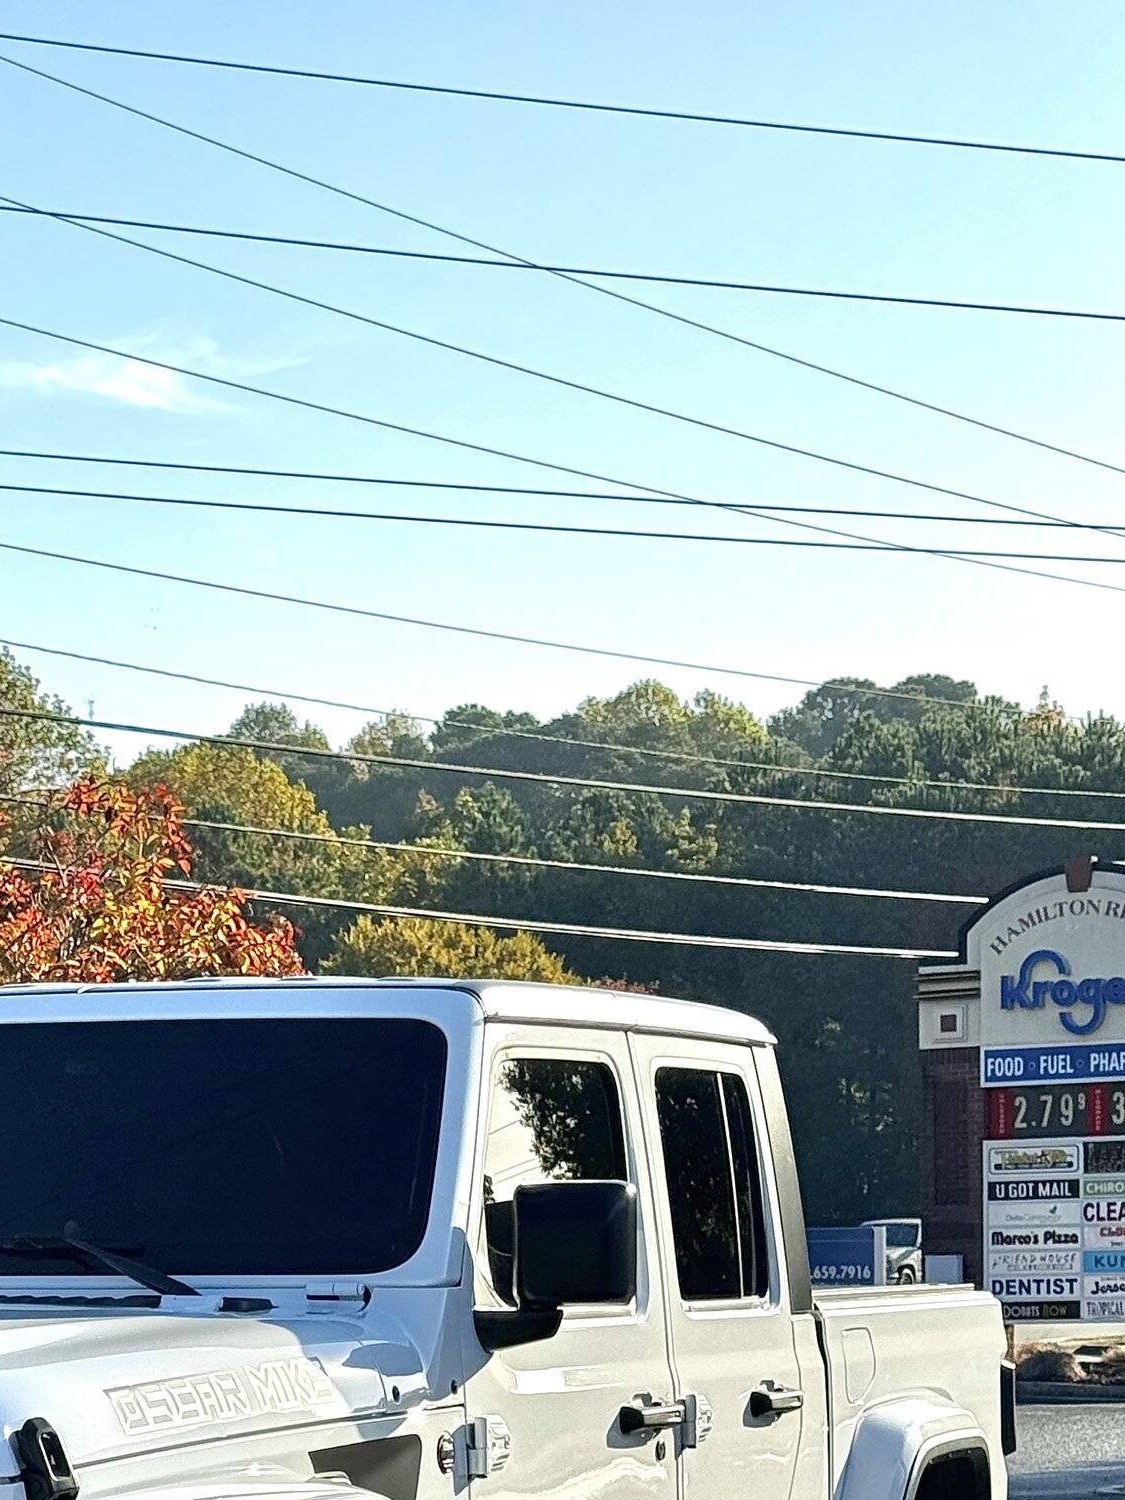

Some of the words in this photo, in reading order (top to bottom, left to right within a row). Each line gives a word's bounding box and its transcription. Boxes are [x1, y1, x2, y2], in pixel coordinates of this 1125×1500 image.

[989, 899, 1101, 955] HAMILTON
[987, 1057, 1024, 1077] FOOD
[1039, 1054, 1074, 1075] FUEL
[995, 1183, 1005, 1198] U
[1008, 1182, 1035, 1198] GOT
[1038, 1181, 1072, 1197] MAIL
[991, 1231, 1039, 1246] Marco's
[1043, 1230, 1079, 1245] Pizza
[992, 1278, 1078, 1296] DENTIST
